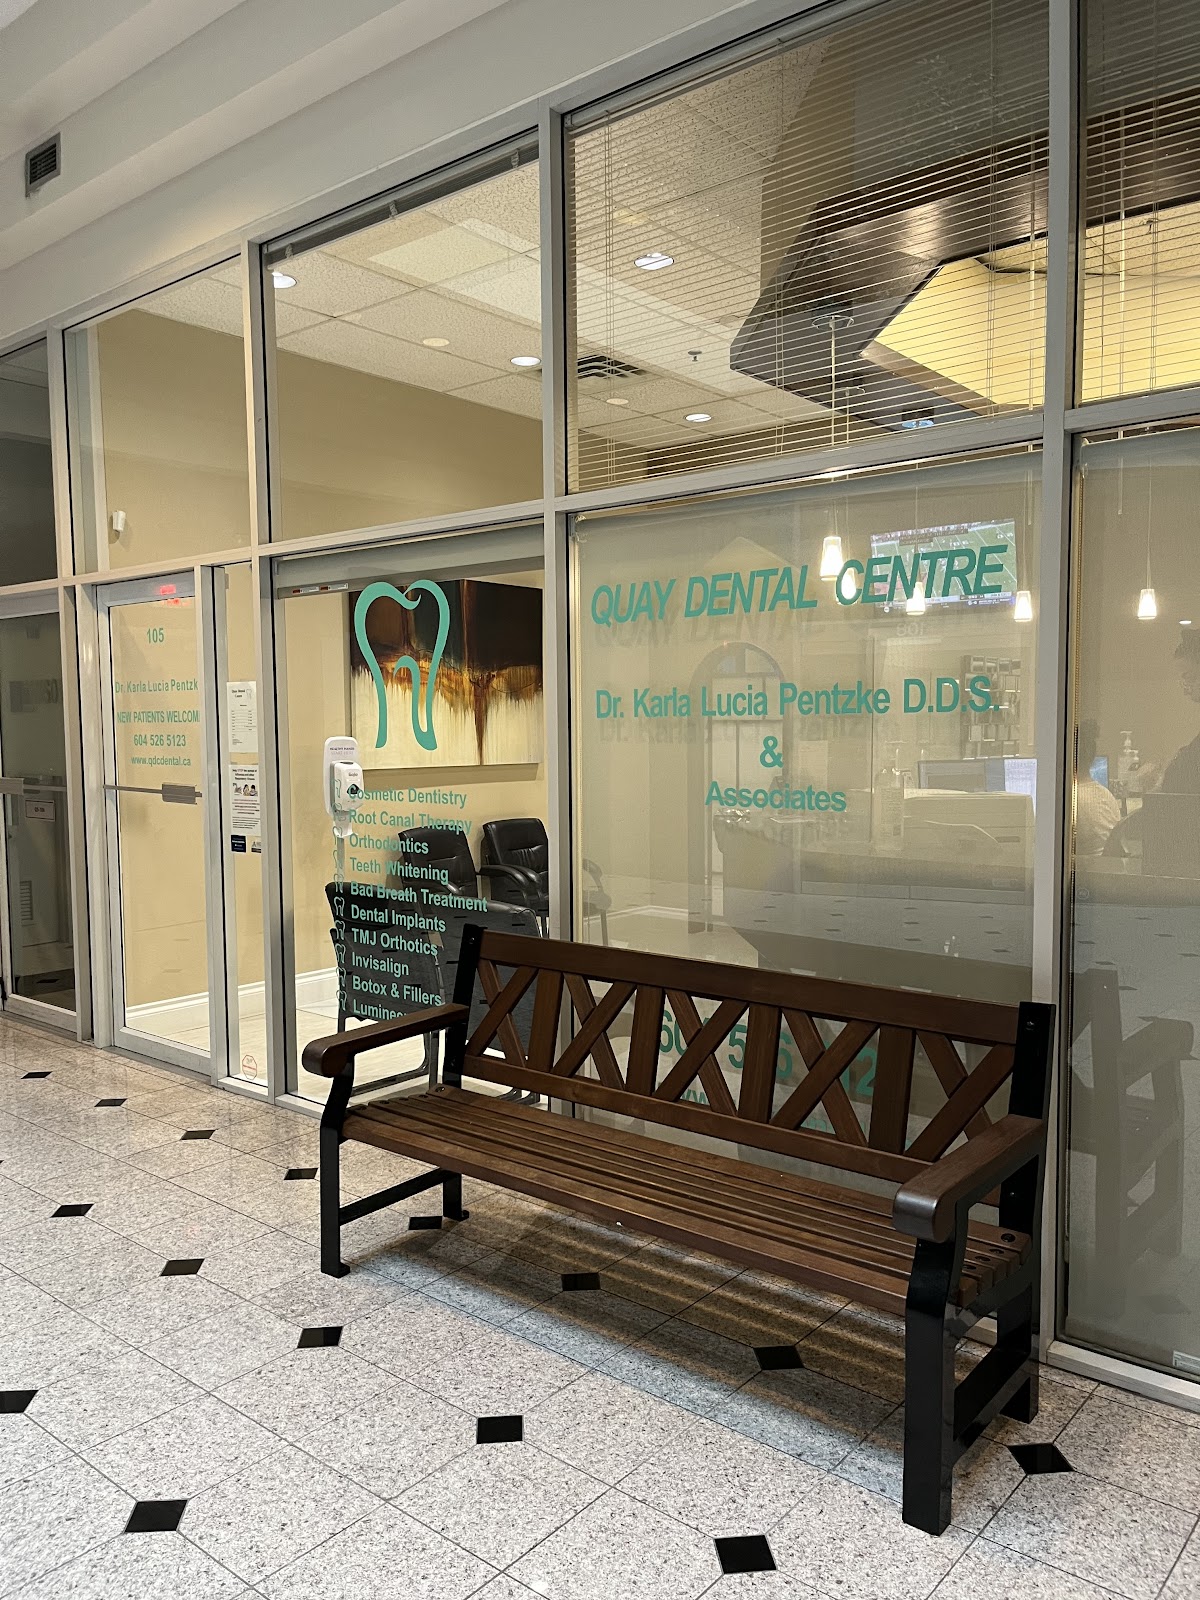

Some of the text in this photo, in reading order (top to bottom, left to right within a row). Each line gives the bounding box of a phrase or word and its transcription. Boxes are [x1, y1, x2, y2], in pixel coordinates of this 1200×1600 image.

[590, 544, 1008, 626] QUAY DENTAL CENTRE
[146, 627, 165, 644] 105
[115, 677, 199, 693] Dr. Karla Lucia Pentzk
[595, 675, 1000, 719] Dr. Karla Lucia Pentzke D.D.S.
[117, 709, 200, 723] NEW PATIENTS WELCOM
[133, 734, 187, 747] 604 526 5123
[759, 735, 785, 768] &
[131, 755, 191, 767] www.qdcdental.ca
[348, 785, 467, 809] Cosmetic Dentistry
[705, 780, 847, 812] Associates
[350, 810, 472, 836] Root Canal Therapy
[349, 833, 429, 854] Orthodontics
[350, 857, 449, 885] Teeth Whitening
[350, 881, 488, 913] Bad Breath Treatment
[351, 904, 446, 932] Dental Implants
[352, 928, 438, 956] TMJ Orthotics
[352, 952, 409, 978] Invisalign
[352, 976, 443, 1006] Botox & Fillers
[353, 999, 408, 1020] Lumine
